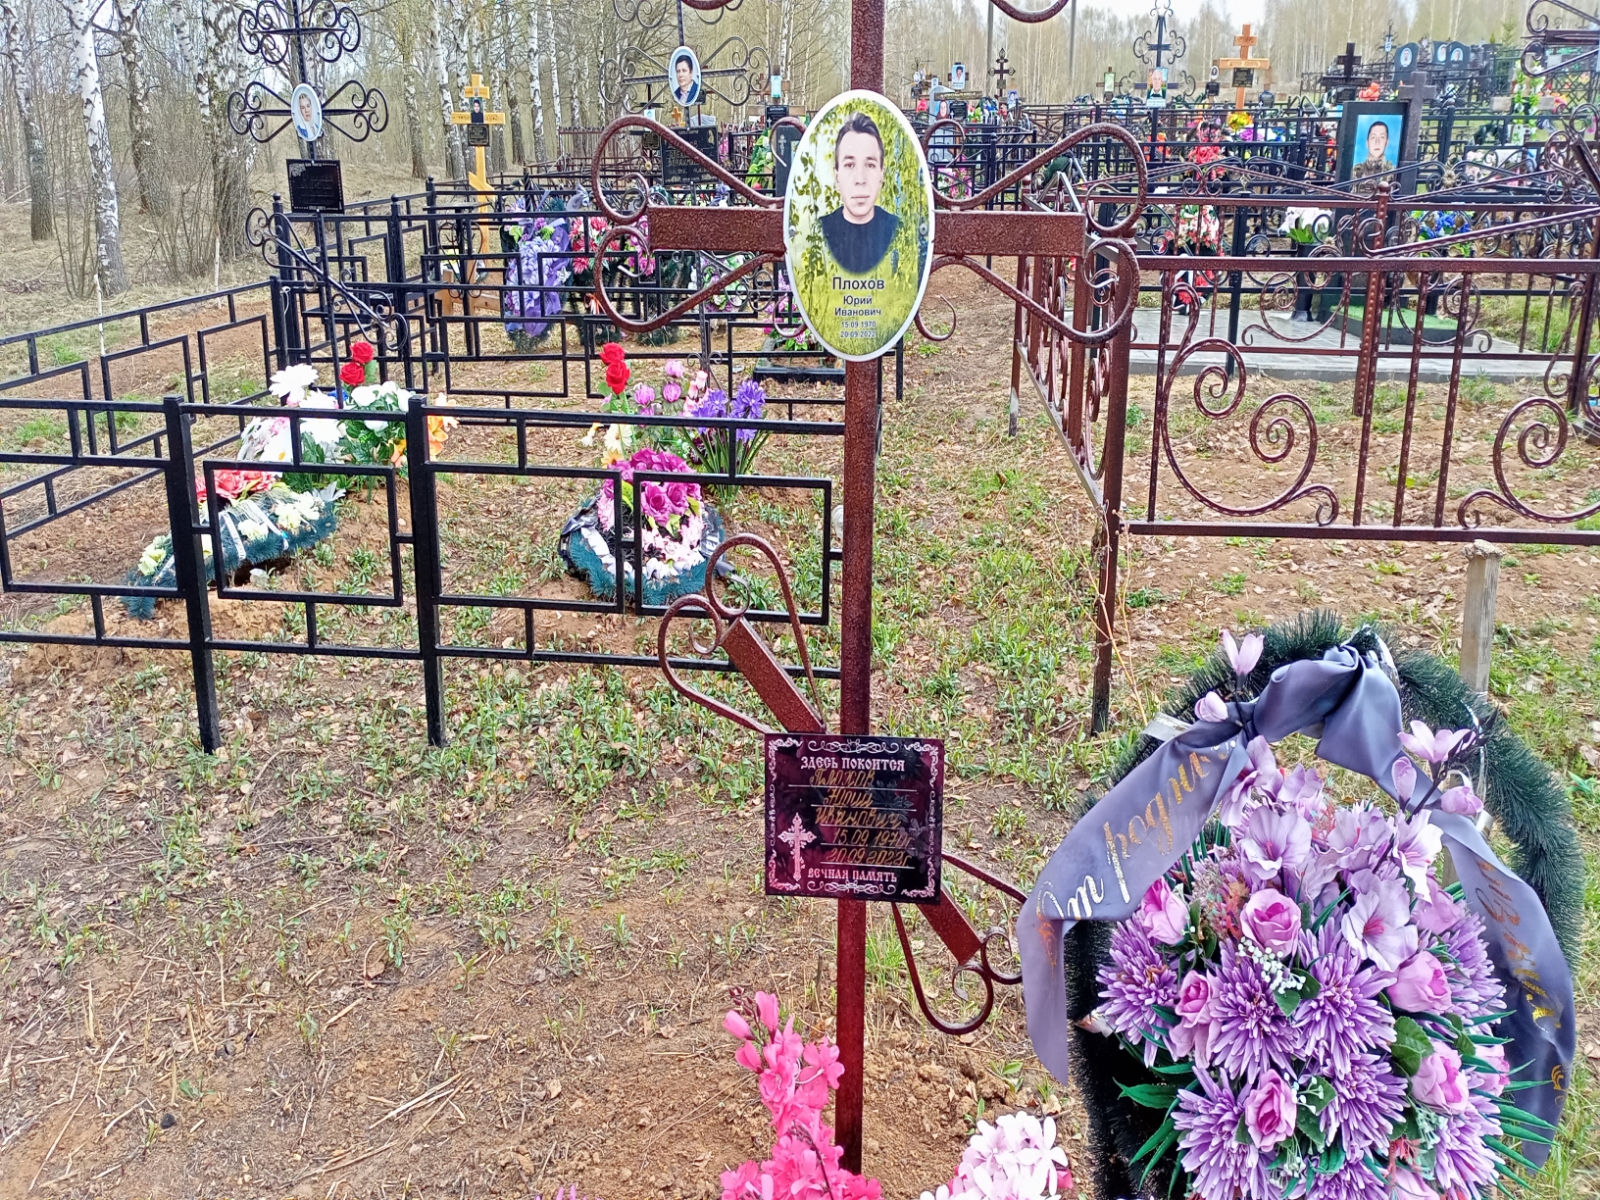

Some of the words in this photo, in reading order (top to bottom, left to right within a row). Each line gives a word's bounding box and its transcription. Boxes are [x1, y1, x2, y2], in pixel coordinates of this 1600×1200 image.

[832, 276, 885, 290] Плохов
[843, 294, 873, 307] Юрий
[834, 307, 882, 316] Иванович
[800, 756, 839, 769] ЗДЕСЬ
[841, 757, 906, 772] ПОКОИТСЯ
[807, 868, 849, 880] ВЕЧНАЯ
[852, 870, 898, 883] ПАМЯТЬ
